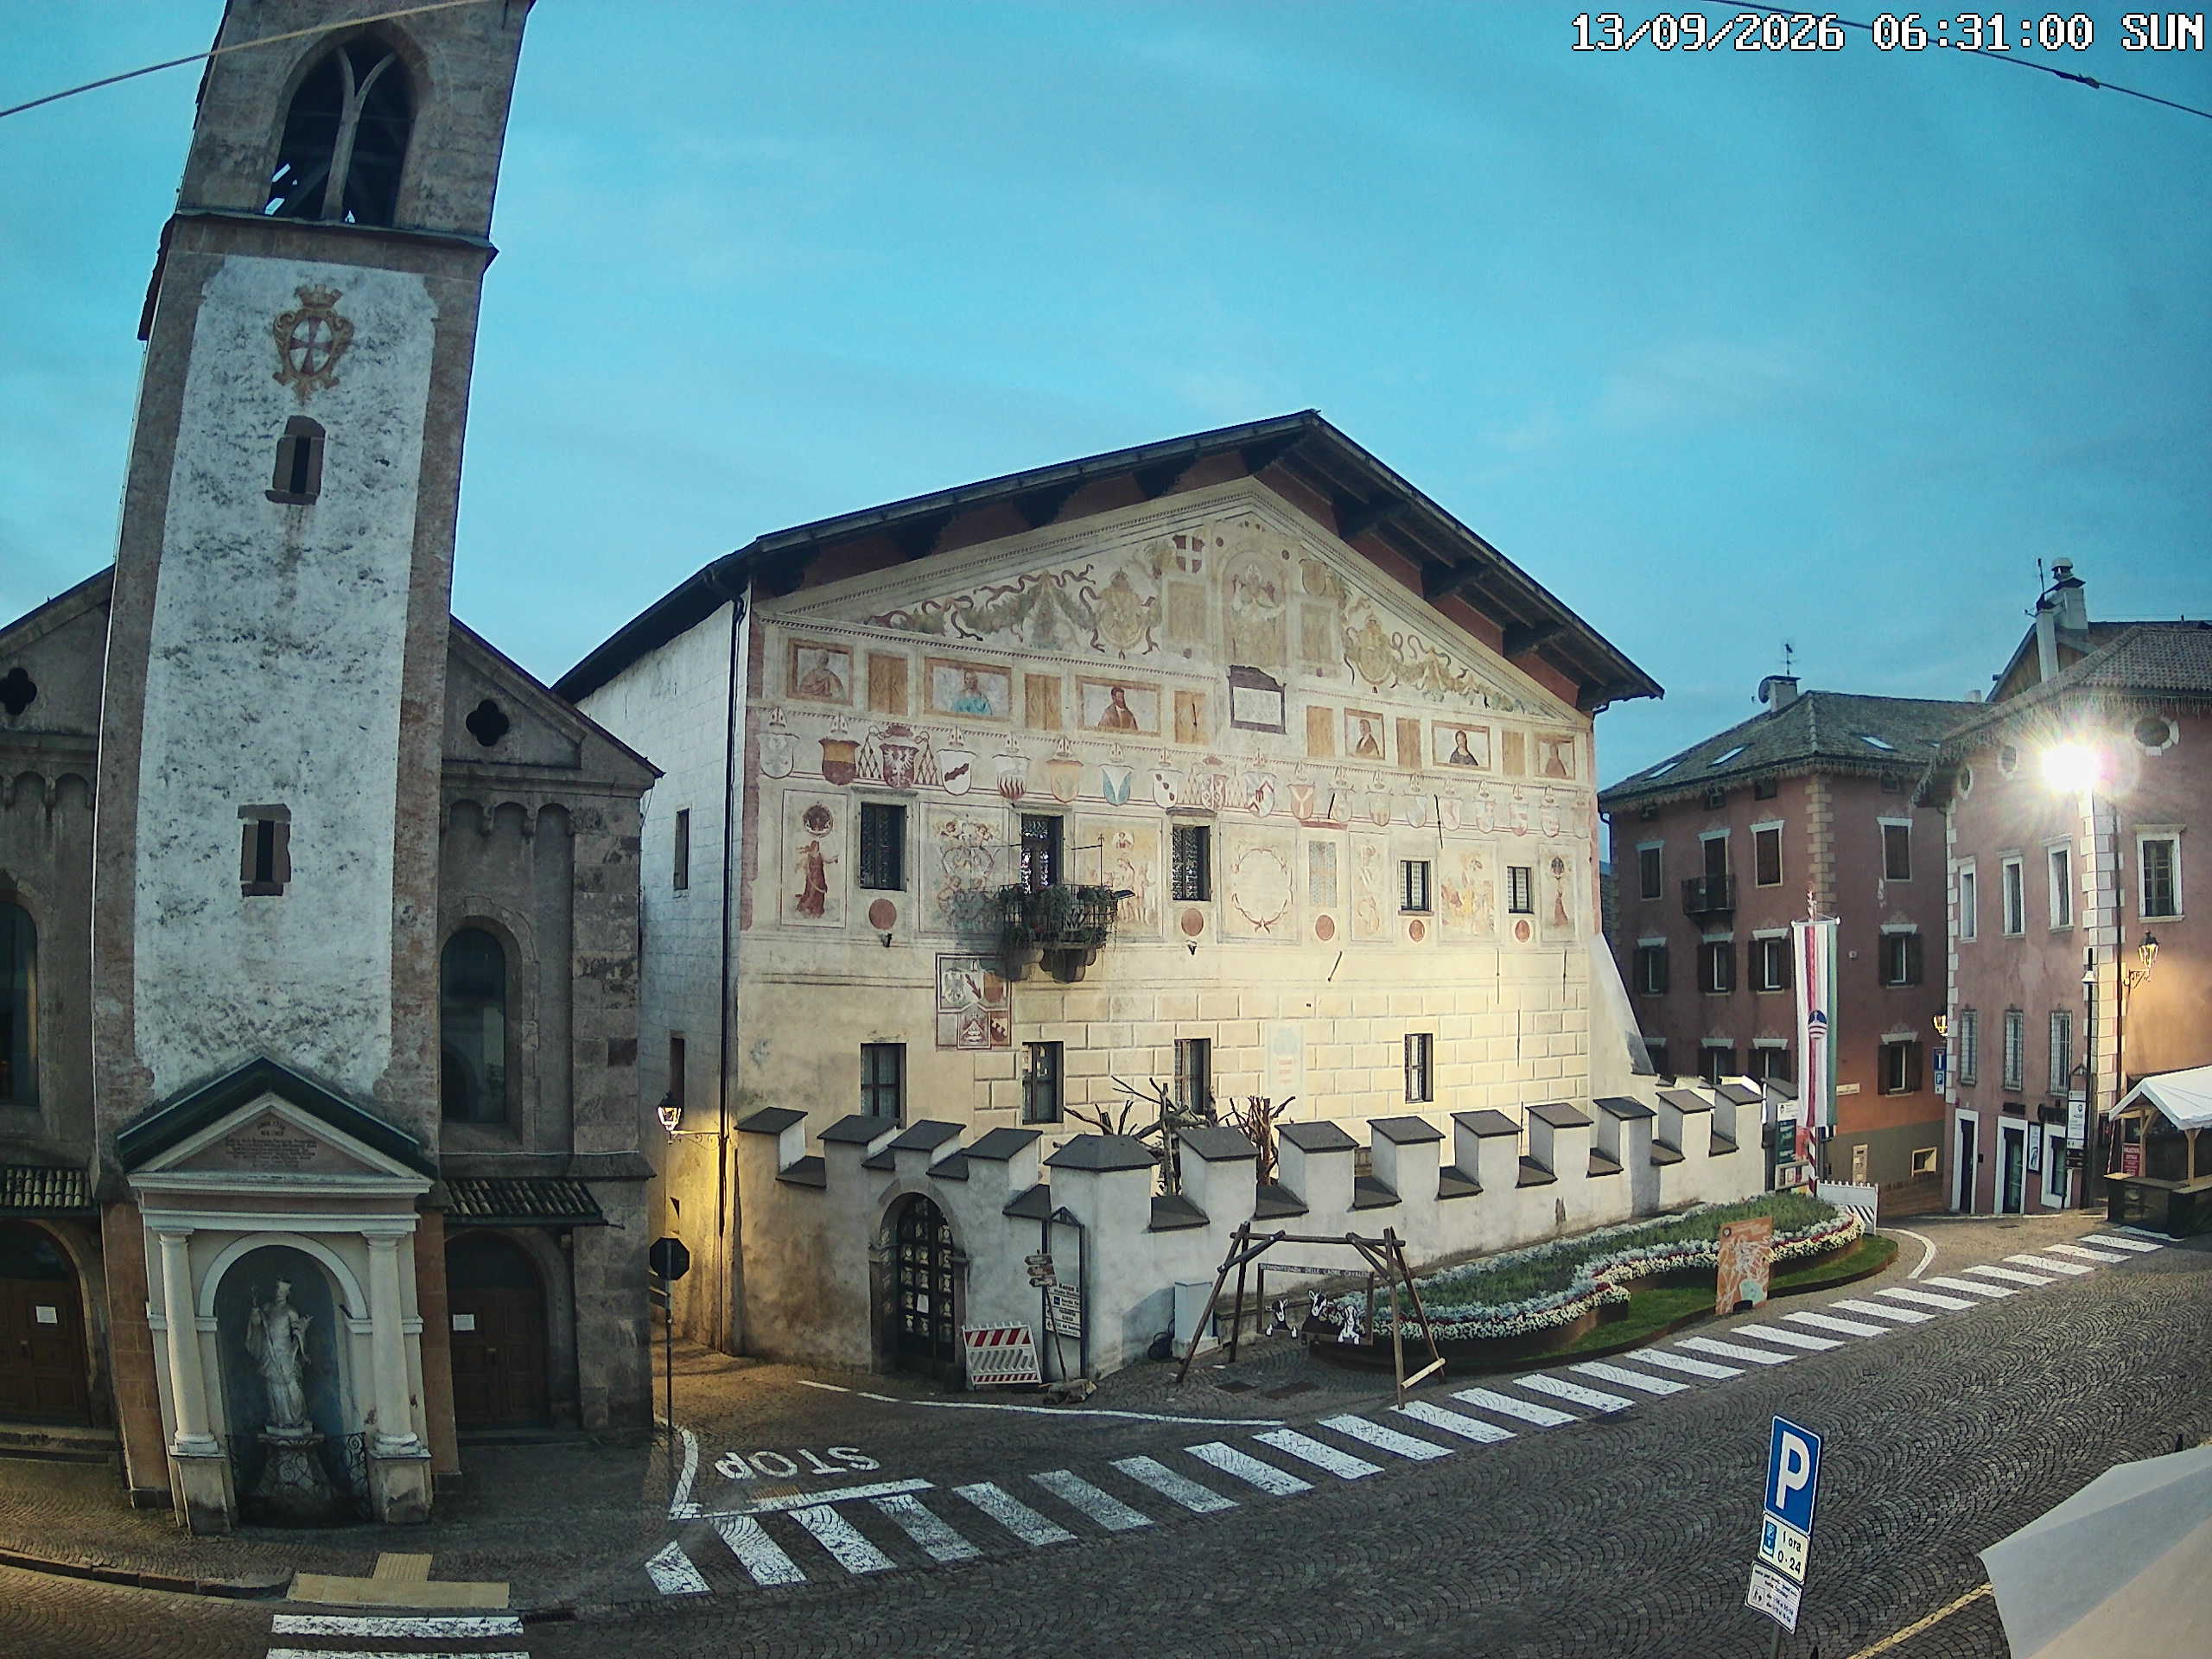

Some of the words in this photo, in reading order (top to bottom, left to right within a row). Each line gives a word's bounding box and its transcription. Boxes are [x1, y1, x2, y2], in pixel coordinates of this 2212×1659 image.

[715, 1446, 880, 1480] STOP
[1776, 1431, 1810, 1510] P
[1789, 1539, 1802, 1553] ora
